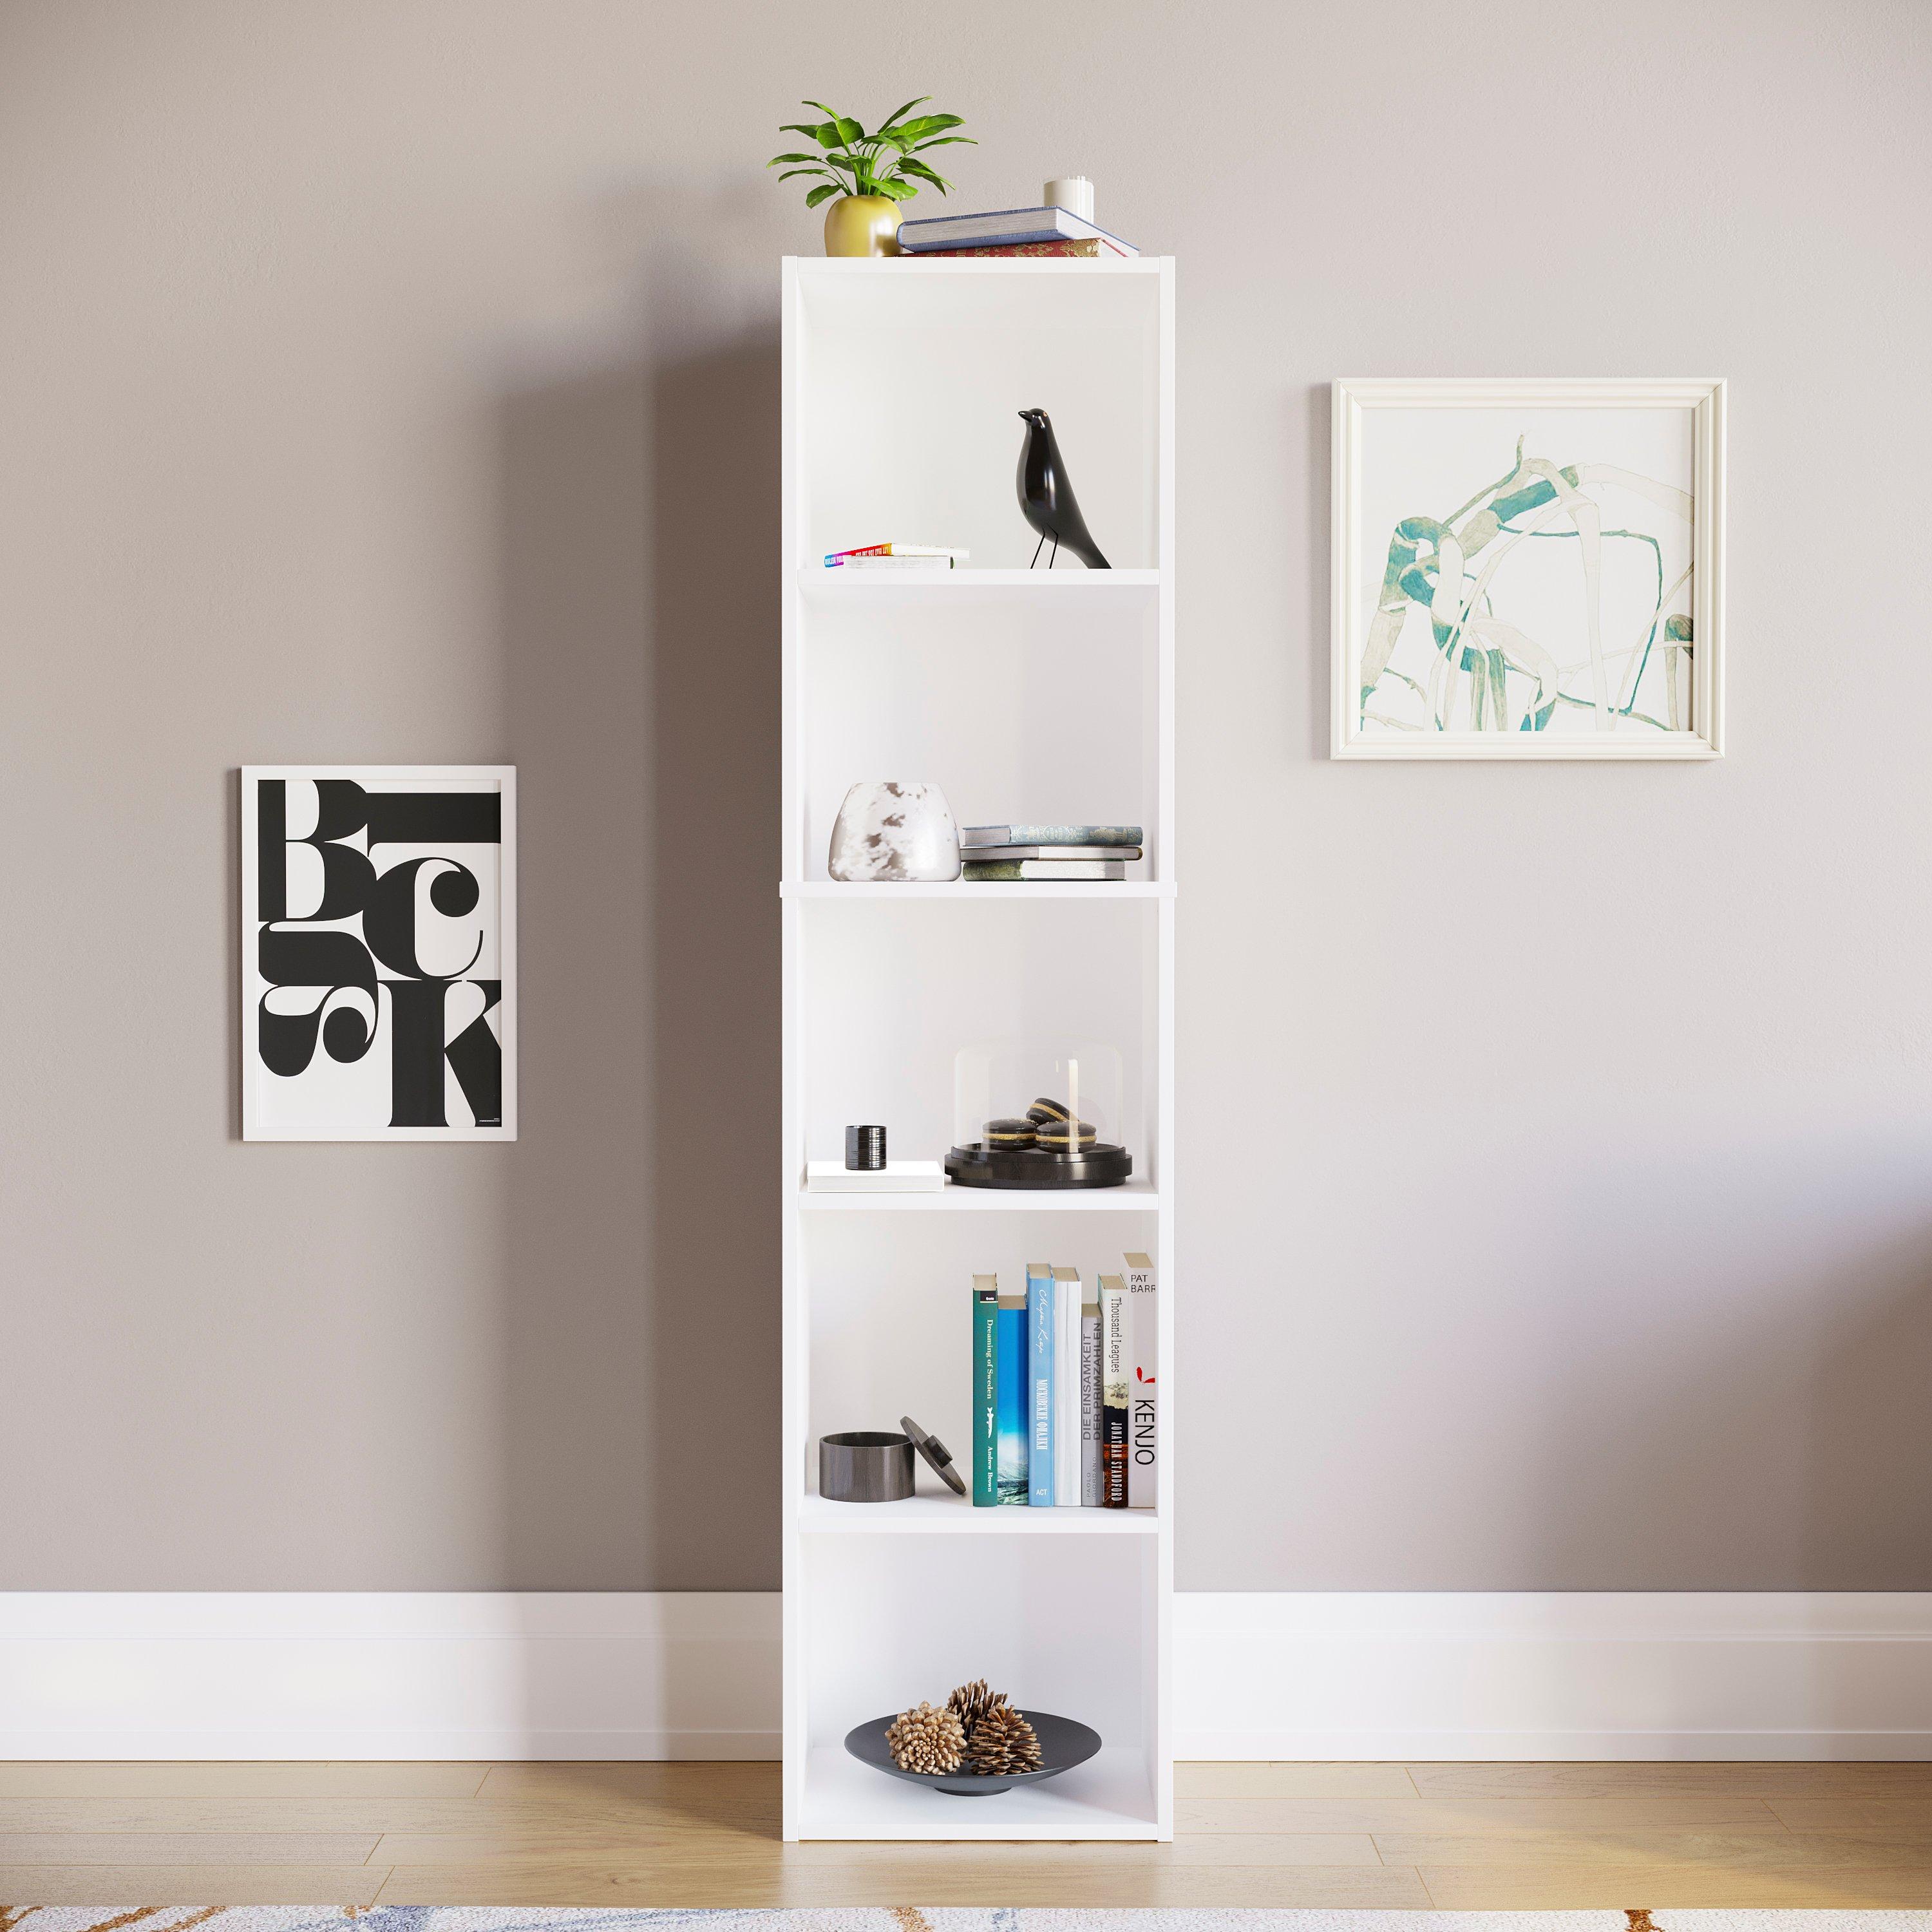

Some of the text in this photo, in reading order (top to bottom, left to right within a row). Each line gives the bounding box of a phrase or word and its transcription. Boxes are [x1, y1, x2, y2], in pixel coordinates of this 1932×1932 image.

[985, 1320, 994, 1358] Dreaming
[987, 1359, 994, 1367] of
[1108, 1297, 1122, 1373] Thousand Leagues
[1083, 1333, 1092, 1441] DIE EINSAMKEIT
[1093, 1323, 1102, 1441] DER PRIMZAHLEN
[1111, 1422, 1122, 1501] JONATHAN STANDFORD
[1135, 1399, 1155, 1465] KENJO
